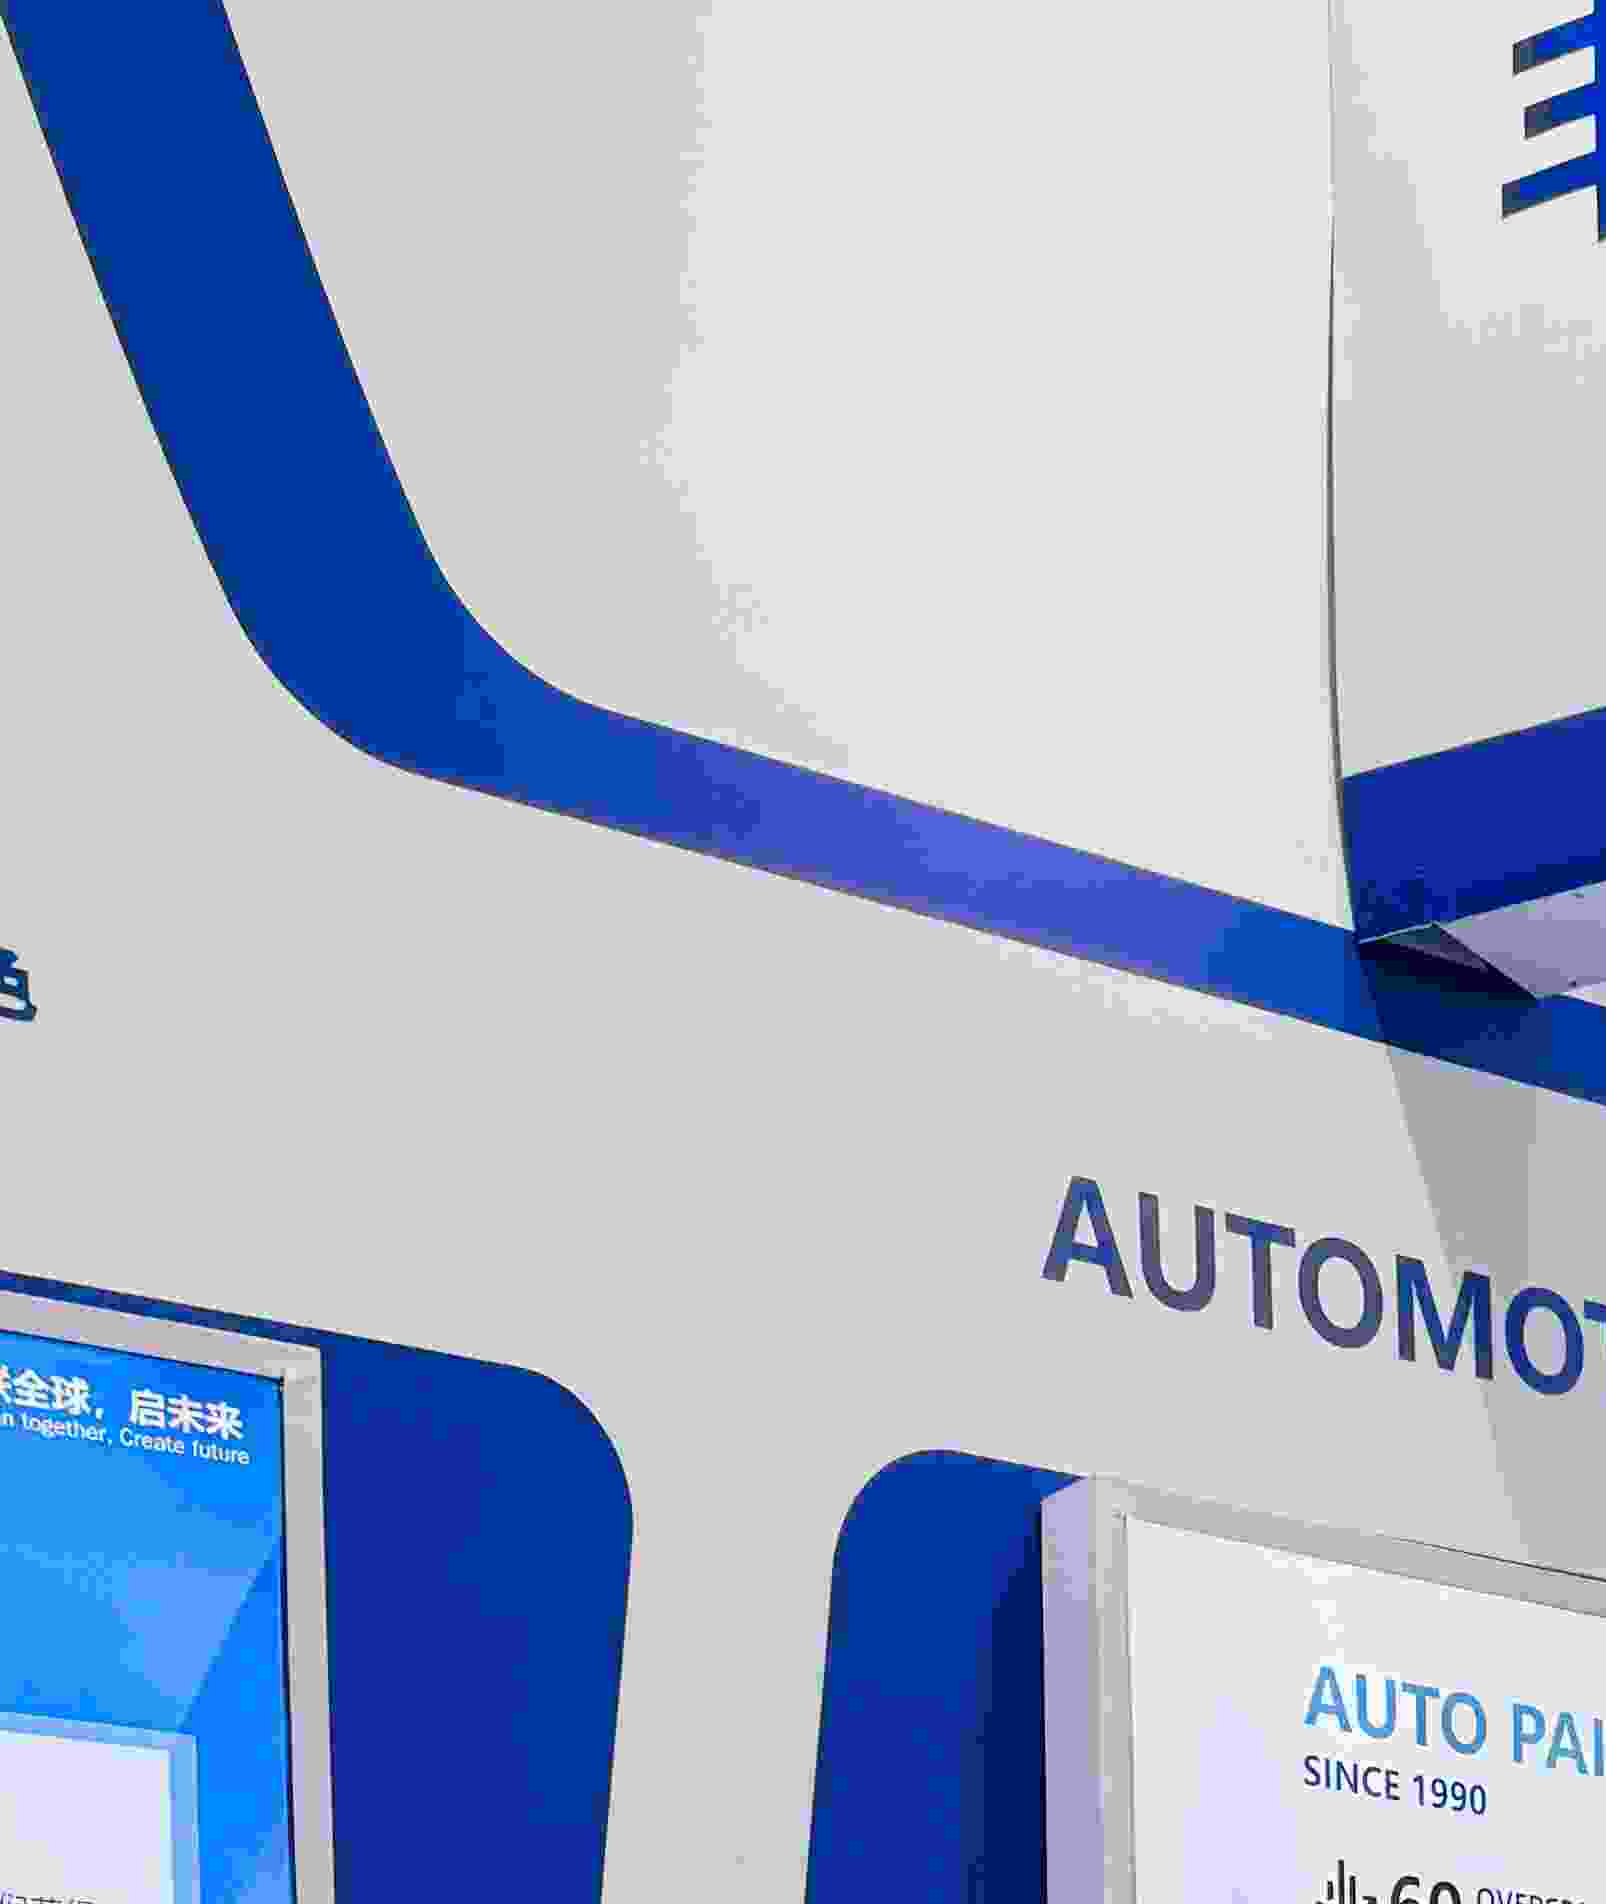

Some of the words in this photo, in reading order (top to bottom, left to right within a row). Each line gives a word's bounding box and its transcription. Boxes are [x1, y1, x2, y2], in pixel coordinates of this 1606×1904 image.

[120, 1427, 184, 1456] Create
[192, 1440, 249, 1465] future
[1304, 1664, 1488, 1756] AUTO
[1303, 1755, 1400, 1800] SINCE
[1413, 1775, 1487, 1815] 1990
